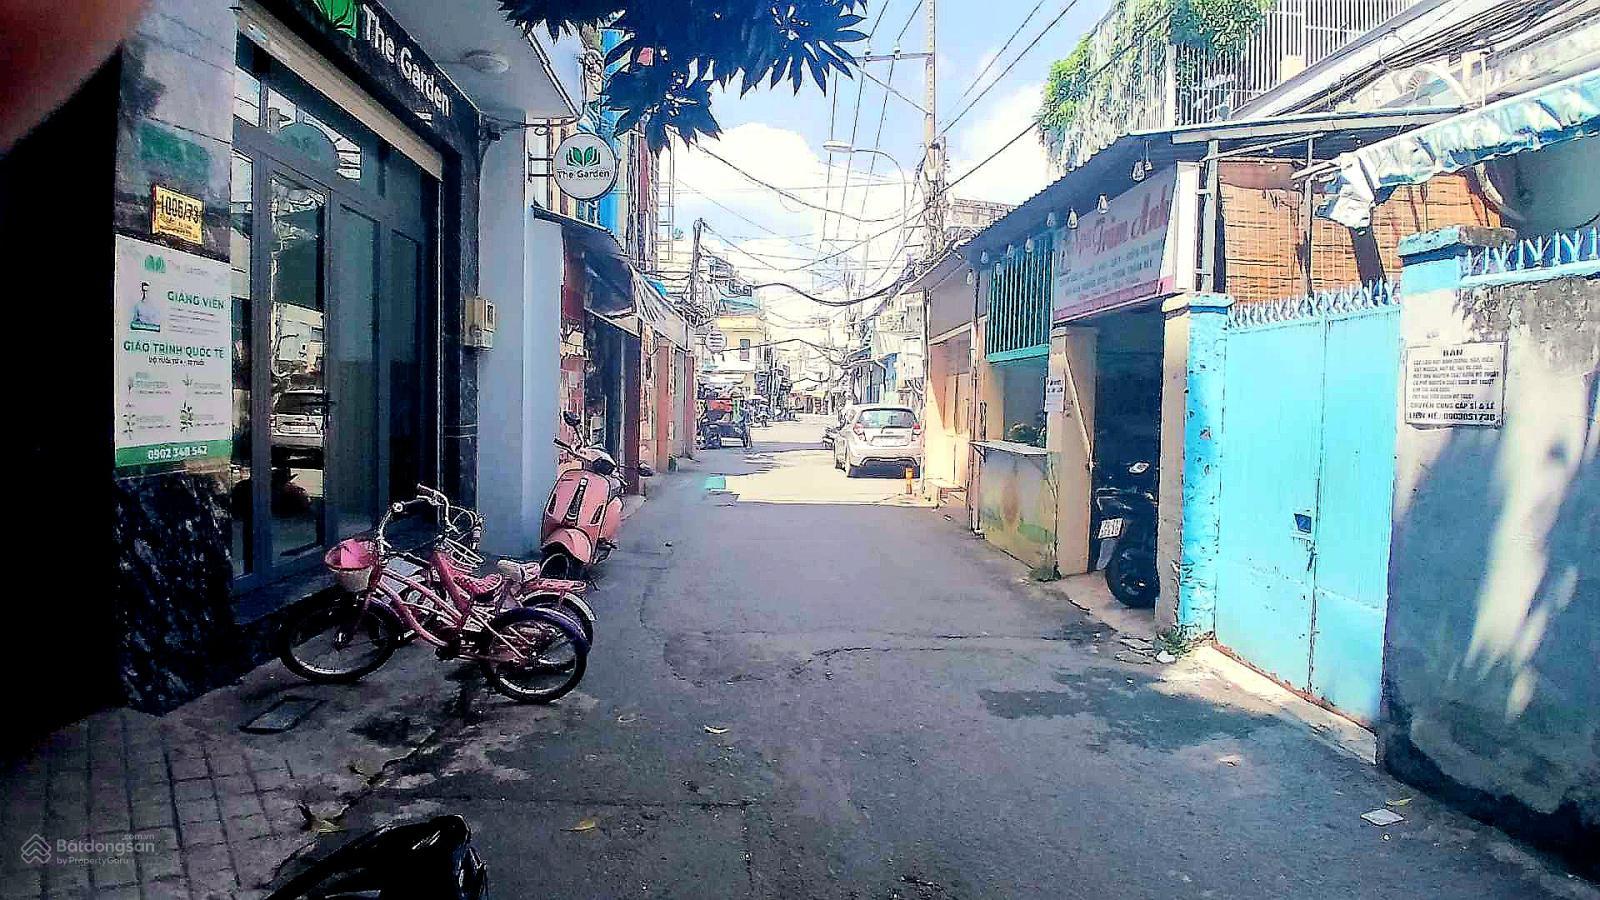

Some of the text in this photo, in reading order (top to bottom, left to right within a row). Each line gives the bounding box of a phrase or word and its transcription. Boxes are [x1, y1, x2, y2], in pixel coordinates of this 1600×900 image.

[362, 3, 451, 117] The Garden
[556, 169, 610, 179] The Garden
